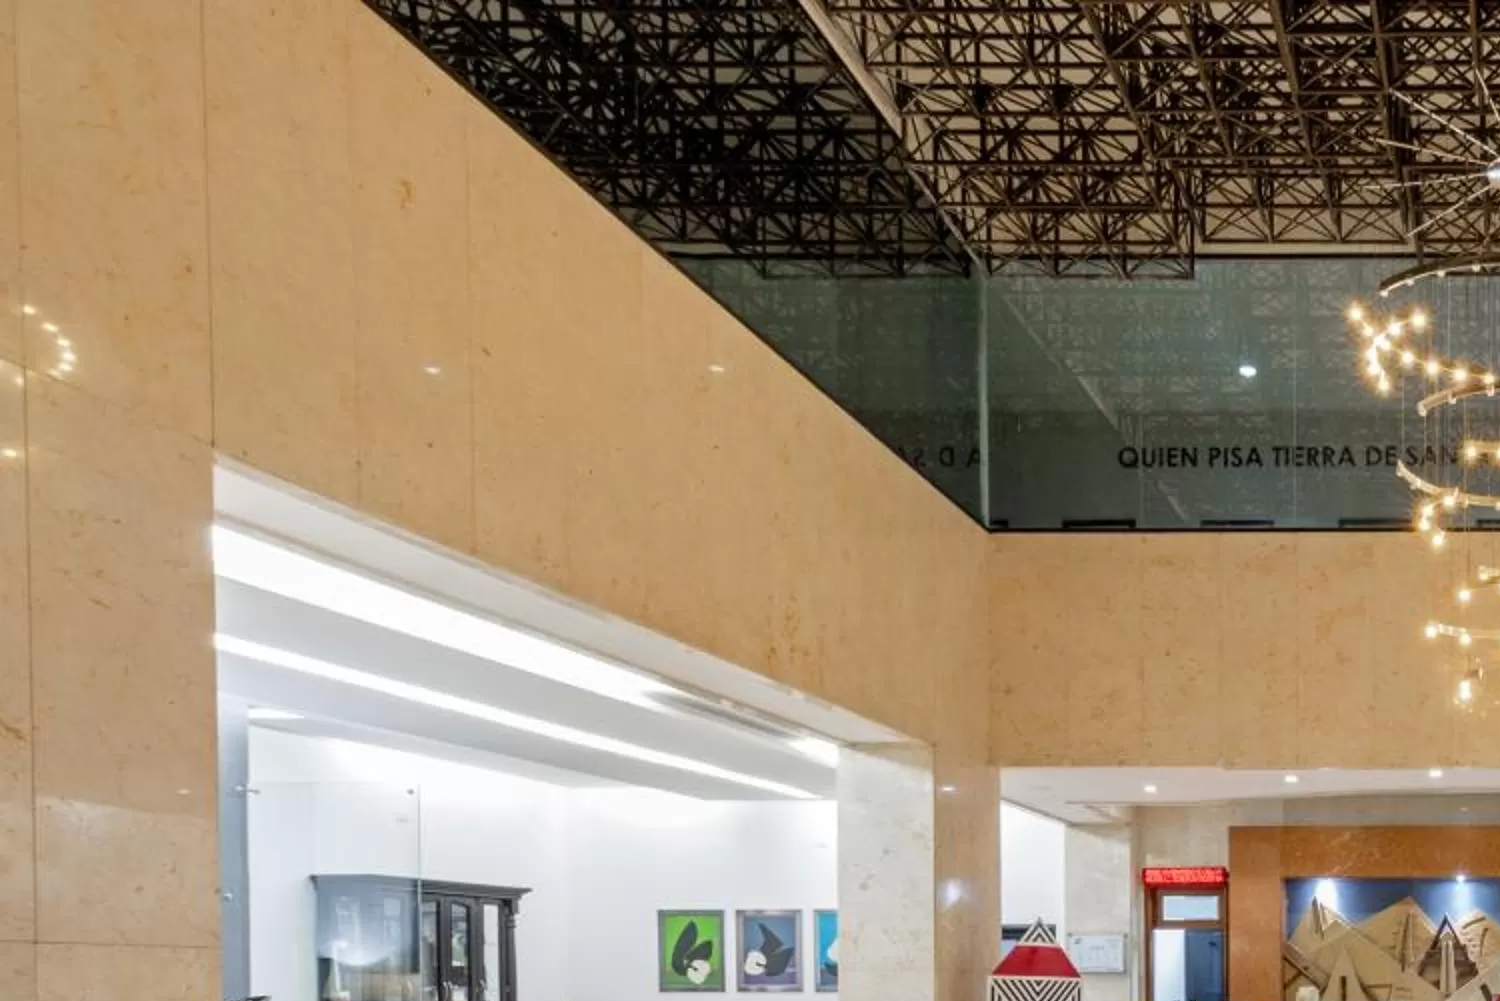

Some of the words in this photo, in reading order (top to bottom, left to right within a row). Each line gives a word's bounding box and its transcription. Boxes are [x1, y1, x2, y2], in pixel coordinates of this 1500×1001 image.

[1117, 446, 1199, 469] QUIEN
[1208, 446, 1264, 469] PISA
[1271, 446, 1356, 468] TIERRA
[1365, 445, 1398, 467] DE
